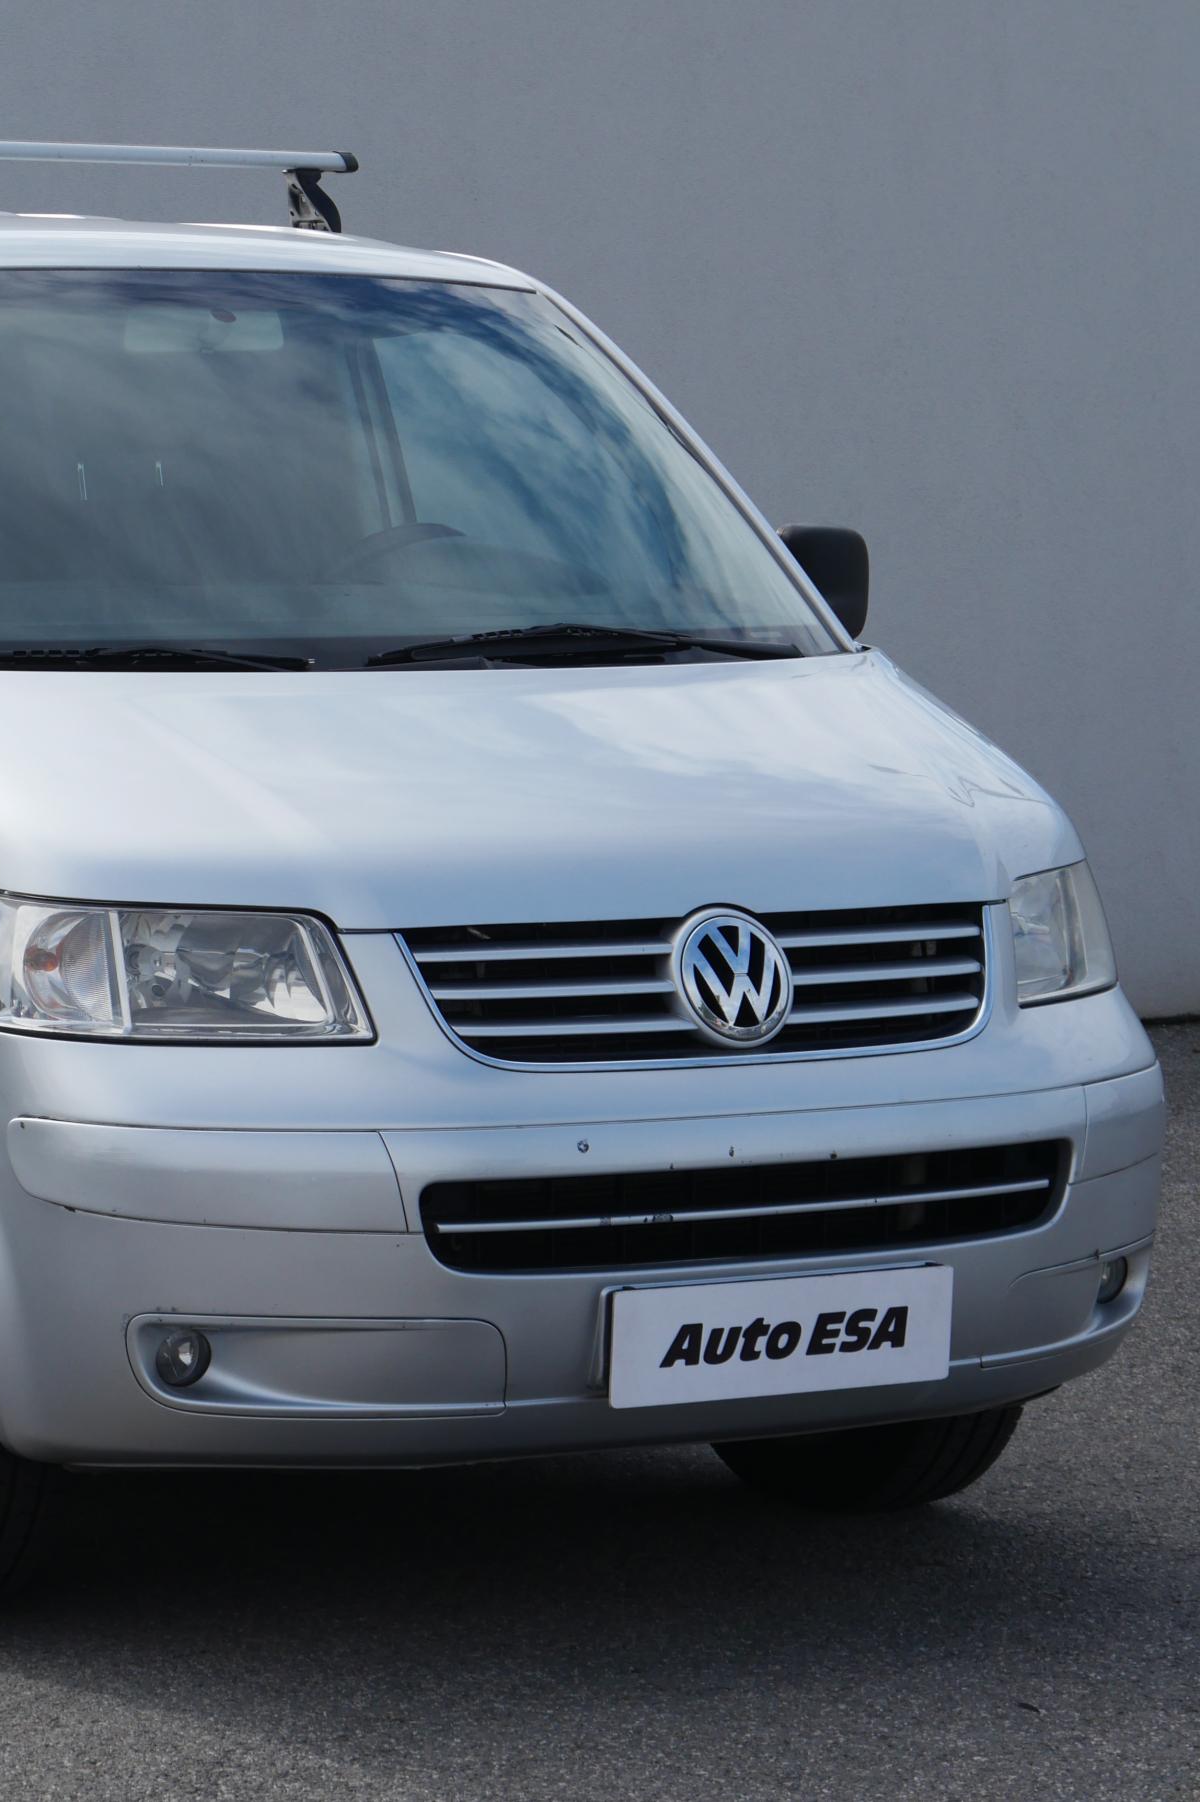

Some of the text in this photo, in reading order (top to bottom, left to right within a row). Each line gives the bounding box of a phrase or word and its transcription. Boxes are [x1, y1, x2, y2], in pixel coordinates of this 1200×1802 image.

[683, 919, 787, 1038] VW
[659, 1305, 909, 1368] Auto ESA
